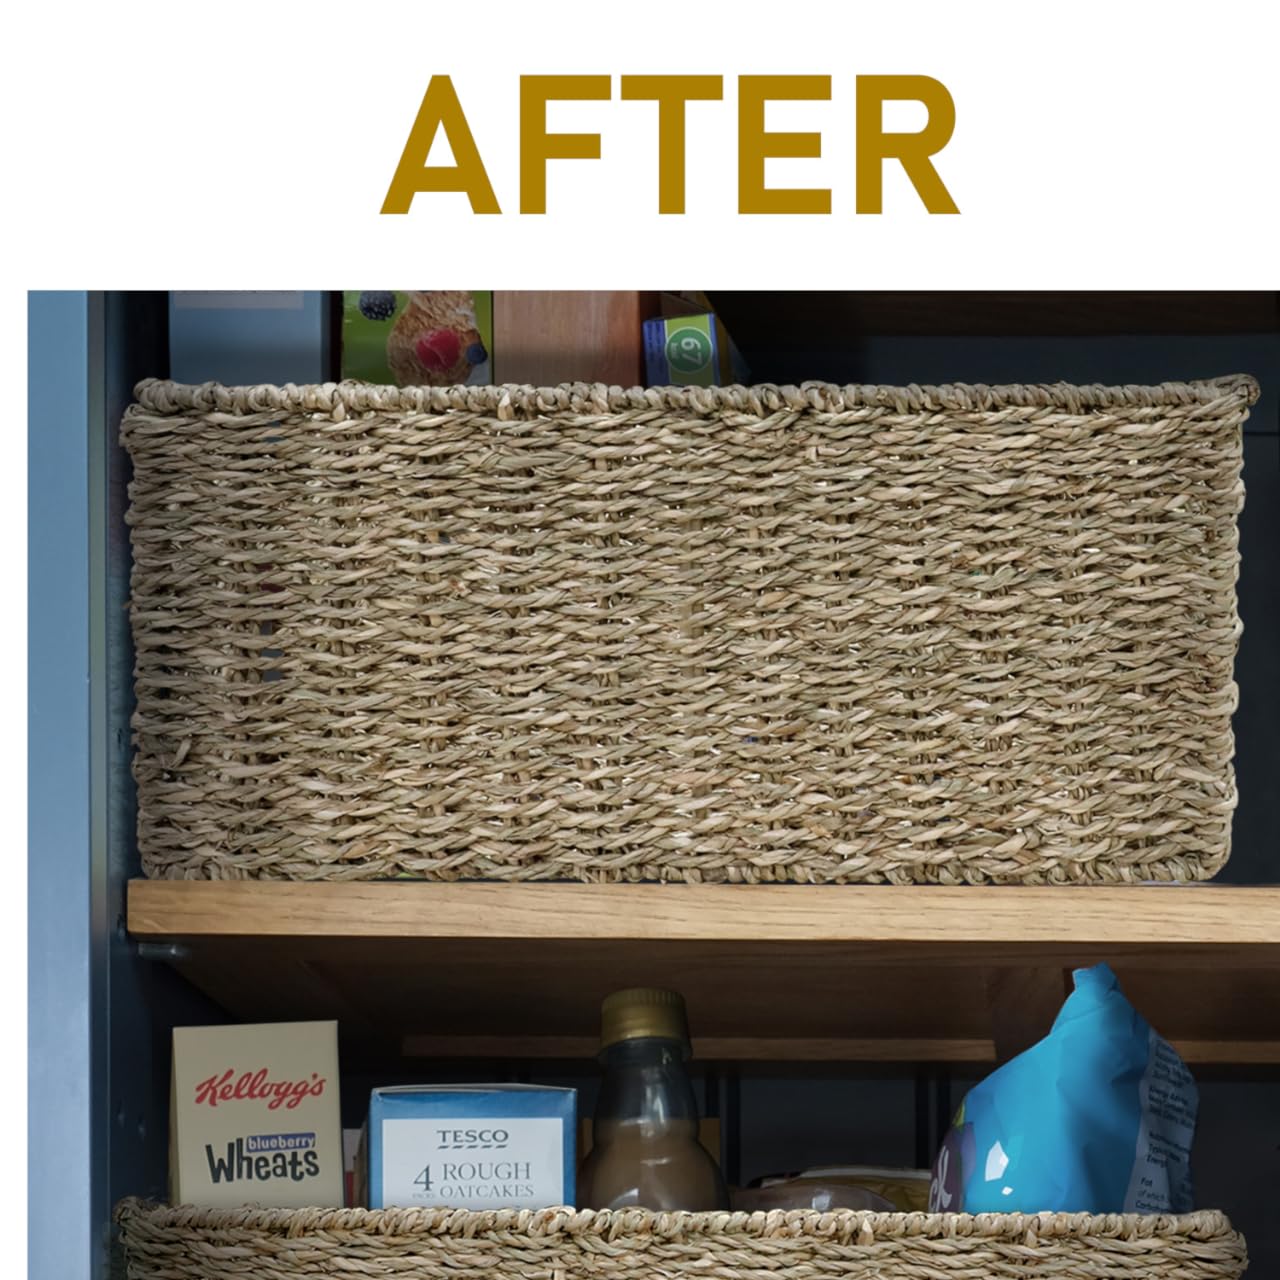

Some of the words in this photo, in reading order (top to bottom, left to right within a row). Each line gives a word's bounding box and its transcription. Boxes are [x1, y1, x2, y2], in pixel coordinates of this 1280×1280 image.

[194, 1067, 327, 1111] Kellogg's
[247, 1134, 317, 1151] blueberry
[436, 1129, 509, 1143] TESCO
[205, 1137, 321, 1184] Wheats
[412, 1164, 434, 1192] 4
[442, 1161, 532, 1181] ROUGH
[439, 1184, 535, 1199] OATCAKES
